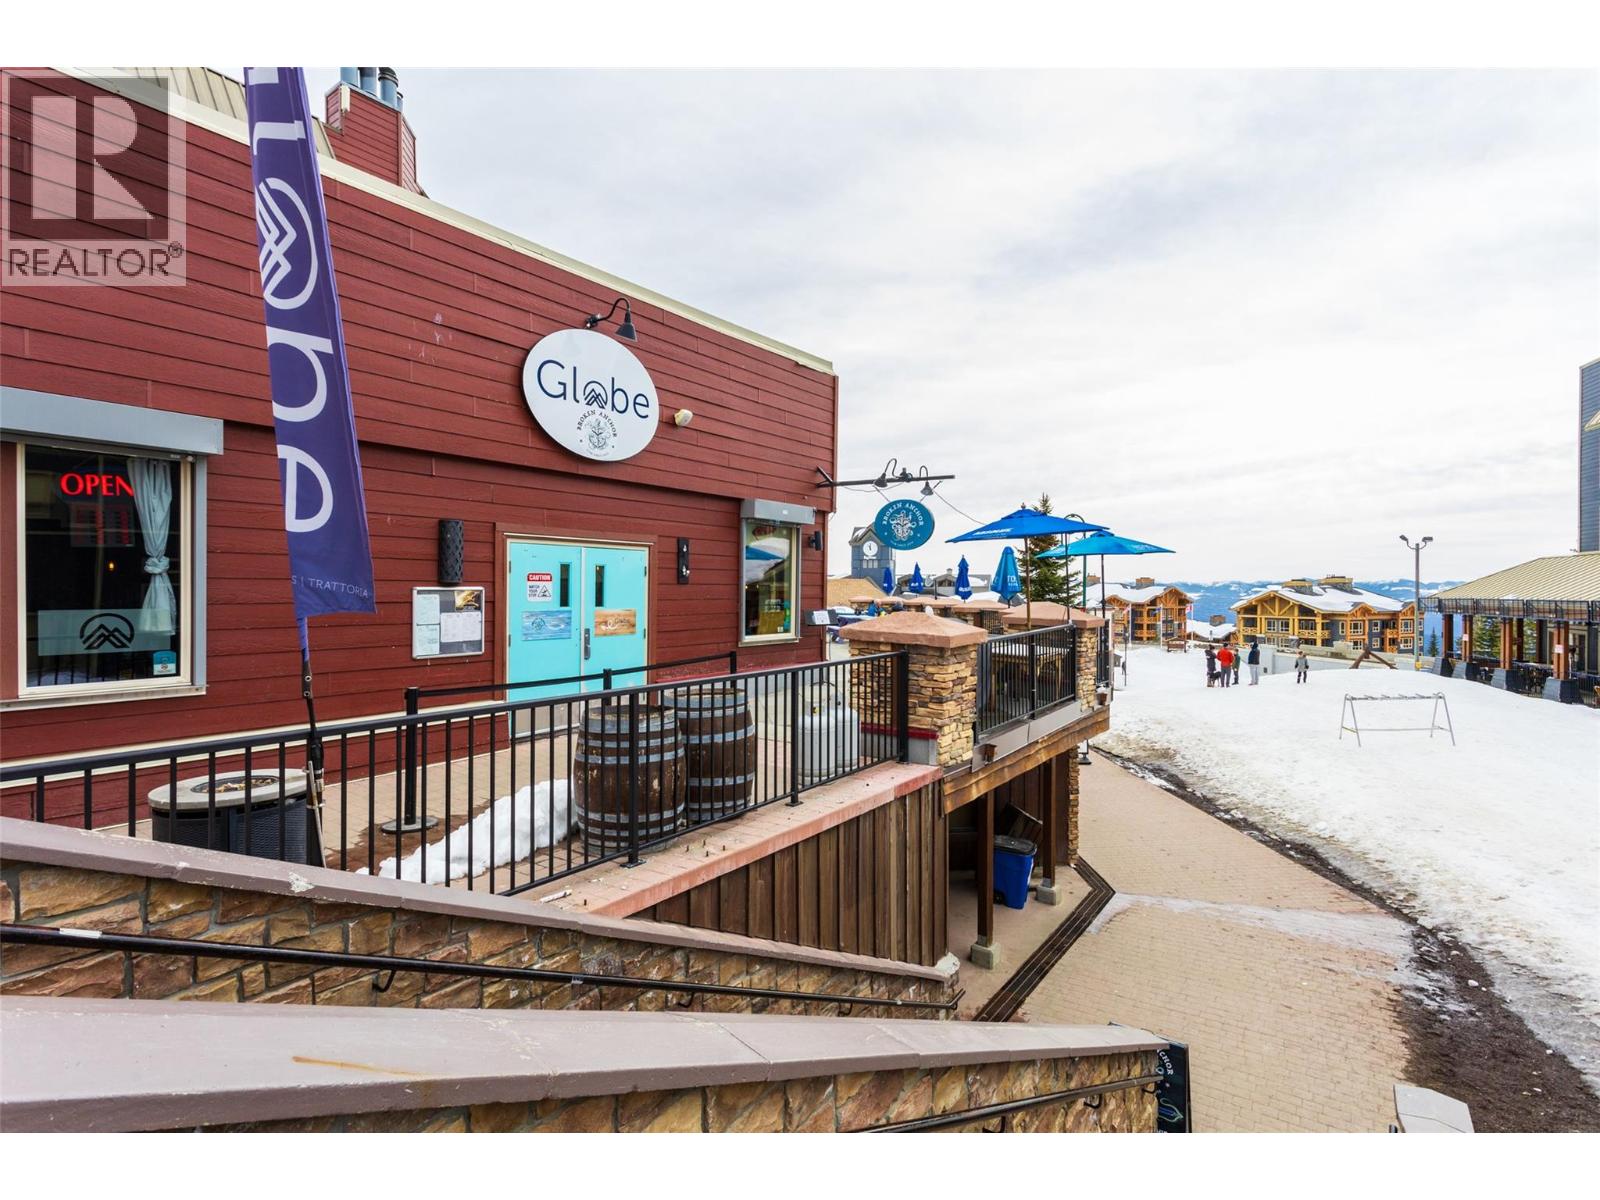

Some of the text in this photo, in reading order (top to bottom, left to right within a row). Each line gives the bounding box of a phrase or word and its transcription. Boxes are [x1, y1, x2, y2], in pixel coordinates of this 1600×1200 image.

[537, 359, 650, 419] Globe
[576, 409, 618, 438] BROKEN ANCHOR
[60, 472, 135, 497] OPEN
[882, 502, 925, 527] BROKEN ANCHOR
[307, 577, 369, 599] TRATTORIA
[528, 573, 551, 581] CAUTION
